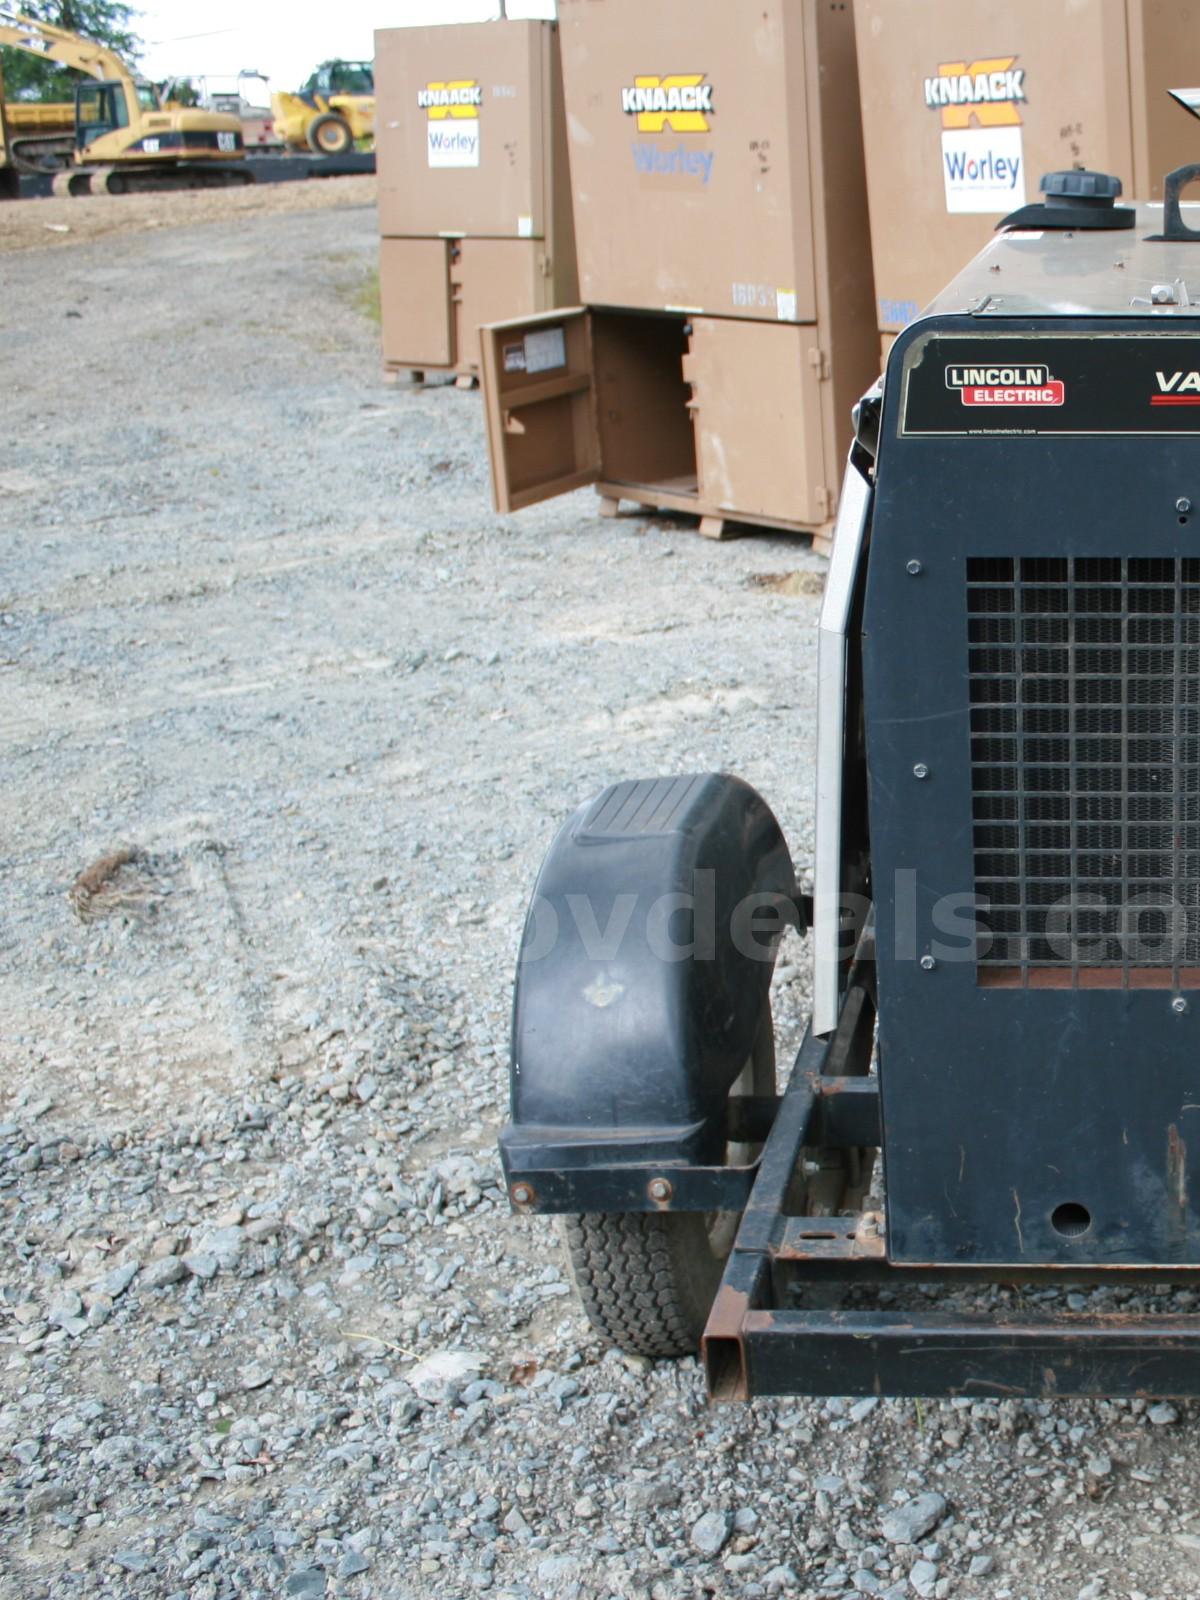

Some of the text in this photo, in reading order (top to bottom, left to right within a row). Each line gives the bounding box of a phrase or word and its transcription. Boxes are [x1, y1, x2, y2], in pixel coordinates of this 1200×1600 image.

[418, 86, 481, 108] KNAACK
[621, 85, 713, 114] KNAACK
[924, 70, 1025, 107] KNAACK
[429, 132, 477, 155] Worley
[631, 143, 714, 185] Worley
[944, 151, 1020, 189] Worley
[951, 368, 1042, 386] LINCOLN
[973, 389, 1054, 402] ELECTRIC
